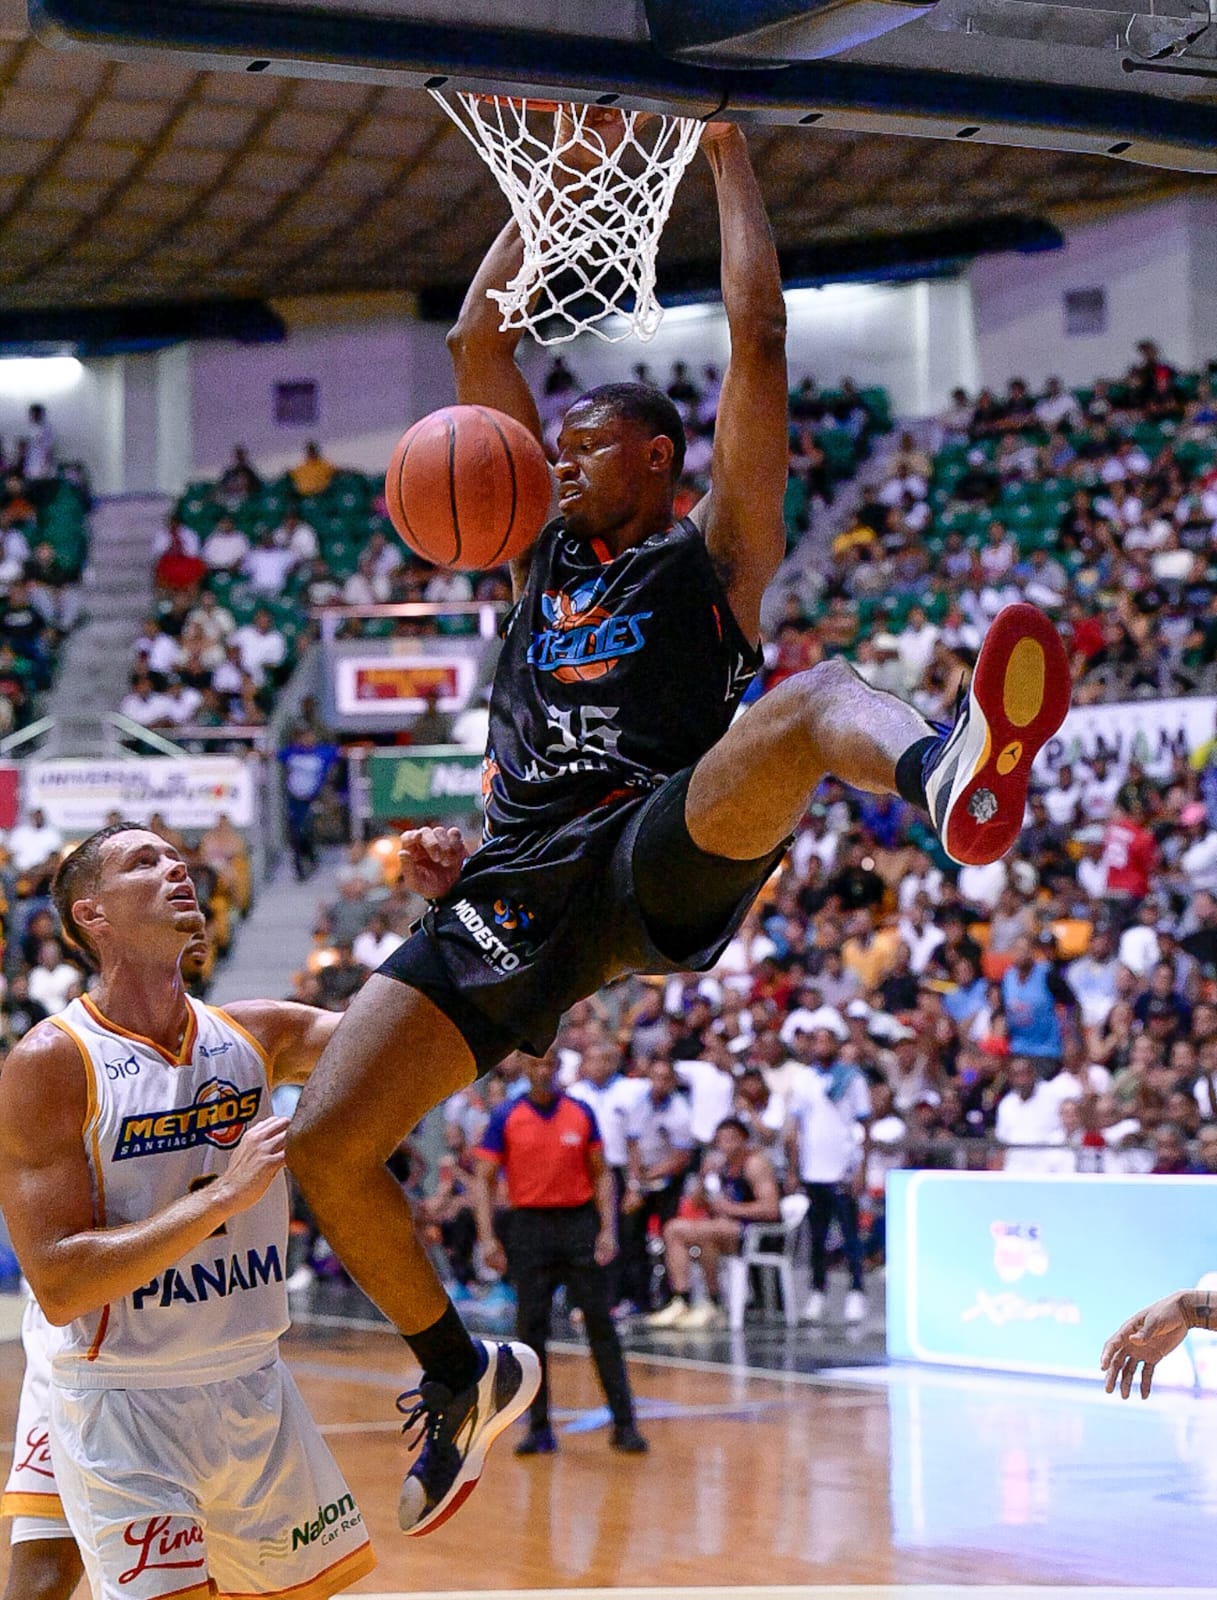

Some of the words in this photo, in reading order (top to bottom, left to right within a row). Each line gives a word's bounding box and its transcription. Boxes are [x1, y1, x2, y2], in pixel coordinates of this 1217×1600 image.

[451, 898, 520, 971] MODESTO
[123, 1093, 257, 1142] METROS
[120, 1133, 197, 1156] SANTIAGO
[133, 1244, 283, 1310] PANAM
[321, 1528, 339, 1546] Car
